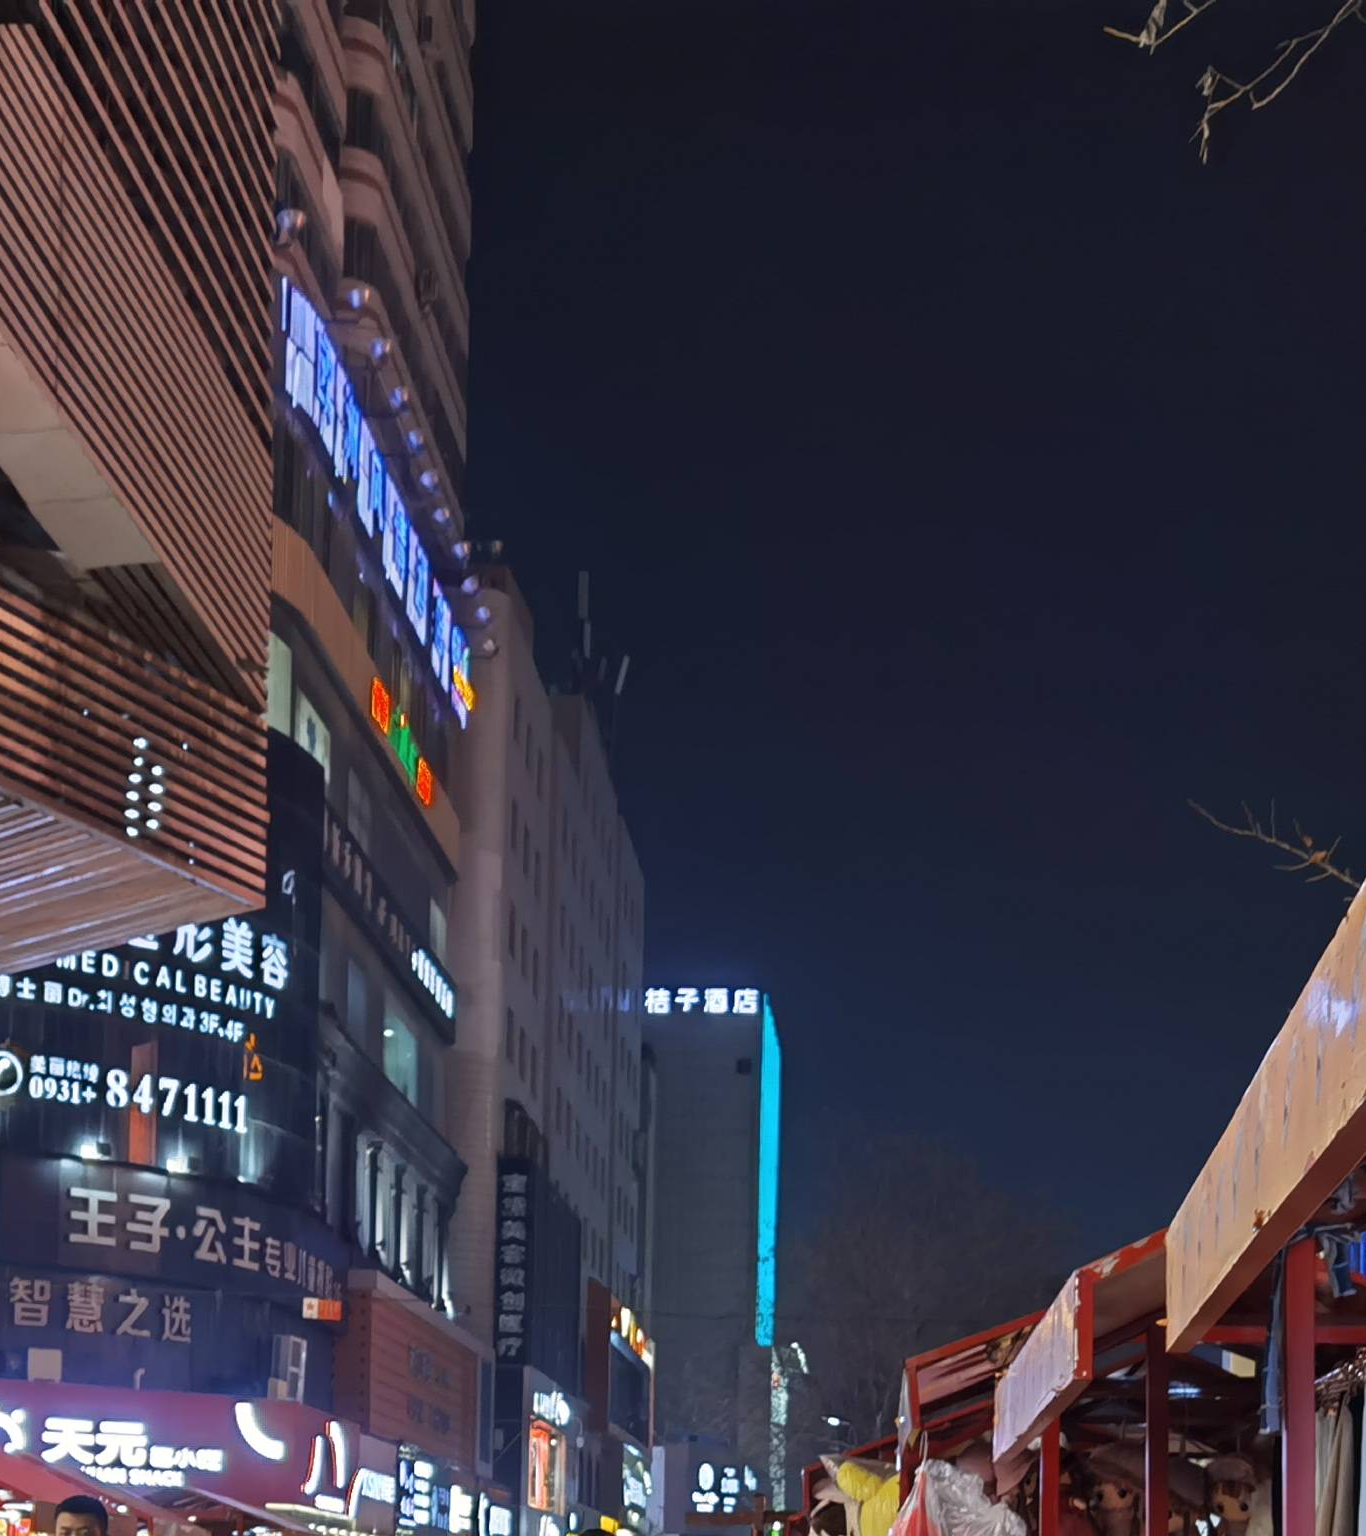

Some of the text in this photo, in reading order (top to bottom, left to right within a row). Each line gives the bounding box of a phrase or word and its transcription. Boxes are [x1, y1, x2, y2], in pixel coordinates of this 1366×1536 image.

[127, 915, 290, 991] 形美容
[194, 973, 276, 1020] BEAUTY
[644, 987, 759, 1014] 桔子酒店
[105, 1068, 248, 1135] 8471111
[9, 1275, 193, 1344] 智慧之选
[40, 1416, 148, 1467] 天元
